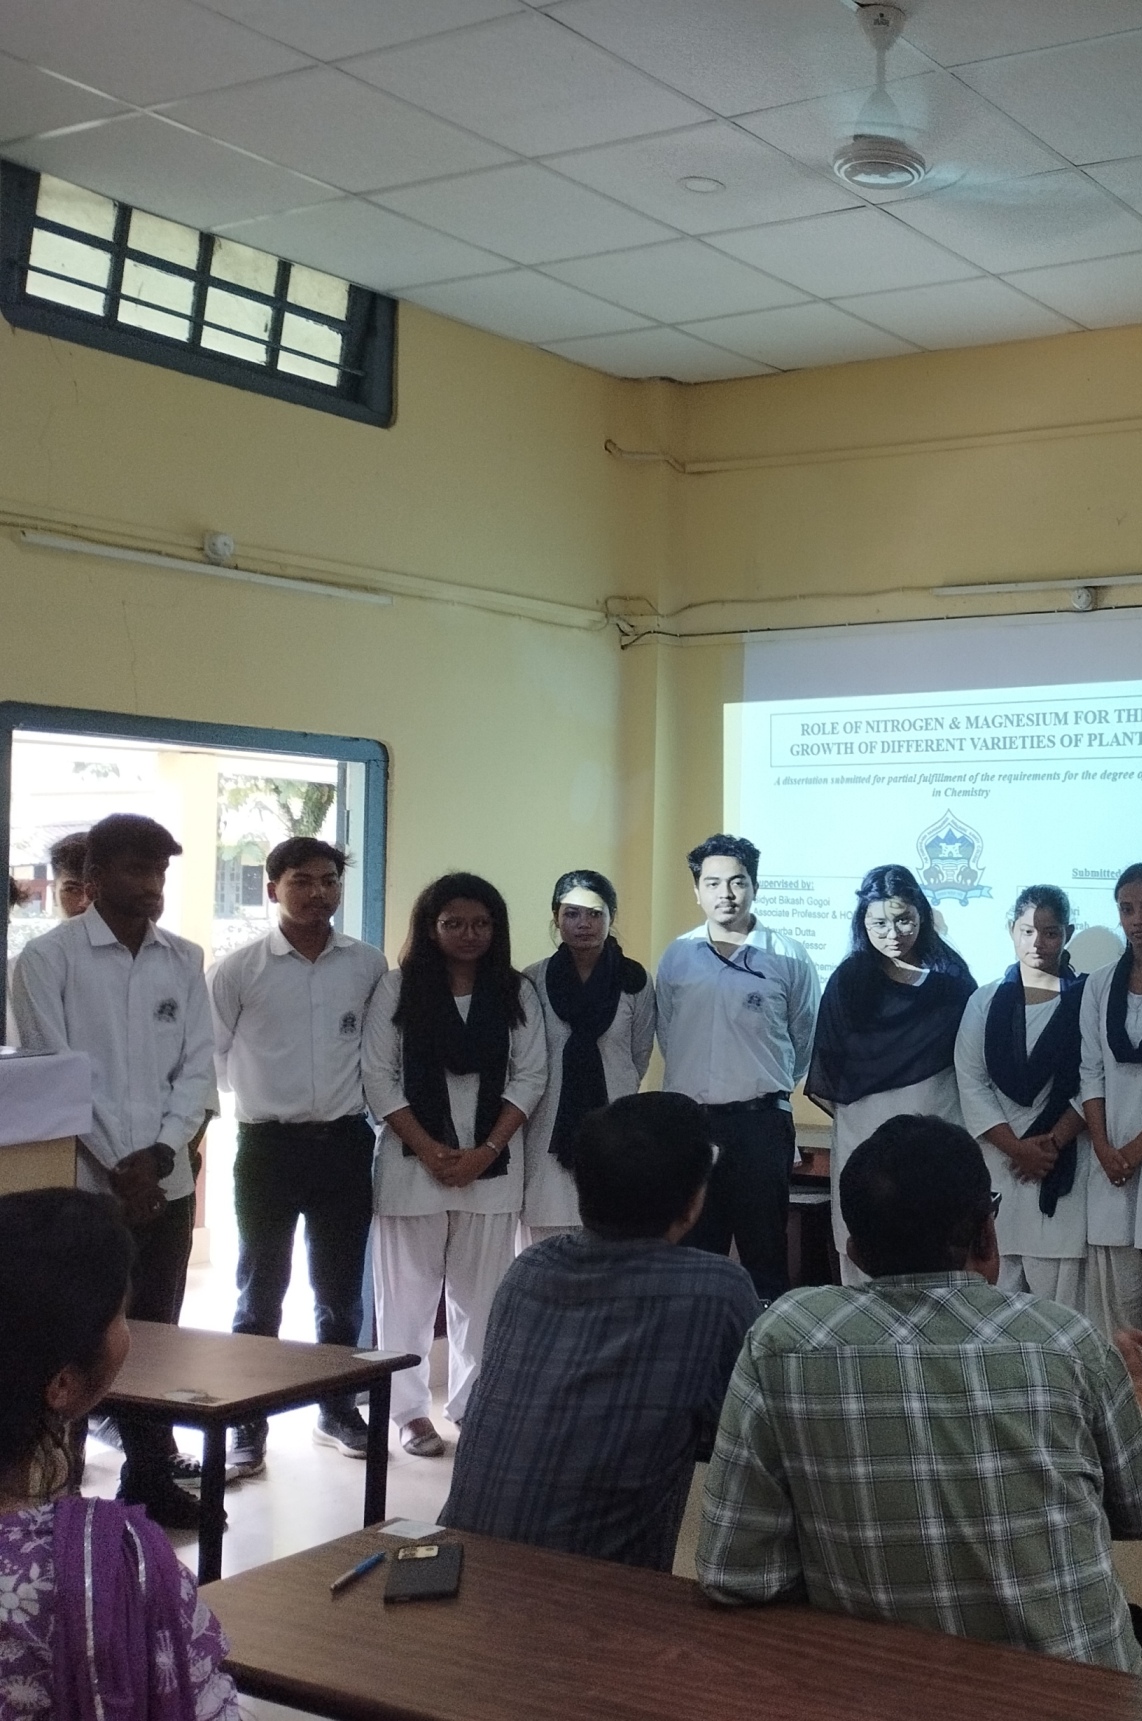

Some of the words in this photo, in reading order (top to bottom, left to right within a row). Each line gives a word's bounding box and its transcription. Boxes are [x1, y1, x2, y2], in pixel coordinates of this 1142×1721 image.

[801, 721, 839, 736] ROLE
[843, 721, 862, 734] OF
[865, 716, 945, 733] NITROGEN
[948, 716, 961, 730] &
[965, 711, 1069, 729] MAGNESIUM
[1074, 708, 1110, 725] FOR
[790, 742, 854, 756] GROWTH
[858, 740, 878, 754] OF
[880, 737, 966, 753] DIFFERENT
[970, 734, 1055, 751] VARIETIES
[1060, 733, 1083, 748] OF
[774, 777, 781, 786] A
[782, 776, 828, 785] dissertation
[830, 775, 870, 785] submitted
[871, 774, 885, 786] for
[887, 773, 916, 786] partial
[917, 772, 966, 785] fulfillment
[968, 772, 980, 784] of
[981, 772, 995, 782] the
[997, 771, 1060, 784] requirements
[1062, 770, 1079, 783] for
[1081, 769, 1097, 780] the
[1100, 769, 1134, 782] degree
[932, 787, 941, 797] in
[944, 787, 990, 798] Chemistry
[759, 879, 799, 888] upervised
[779, 895, 804, 905] Bikash
[807, 896, 830, 908] Gogoi
[792, 908, 829, 919] Professor
[839, 911, 853, 919] HO
[795, 926, 816, 937] Dutta
